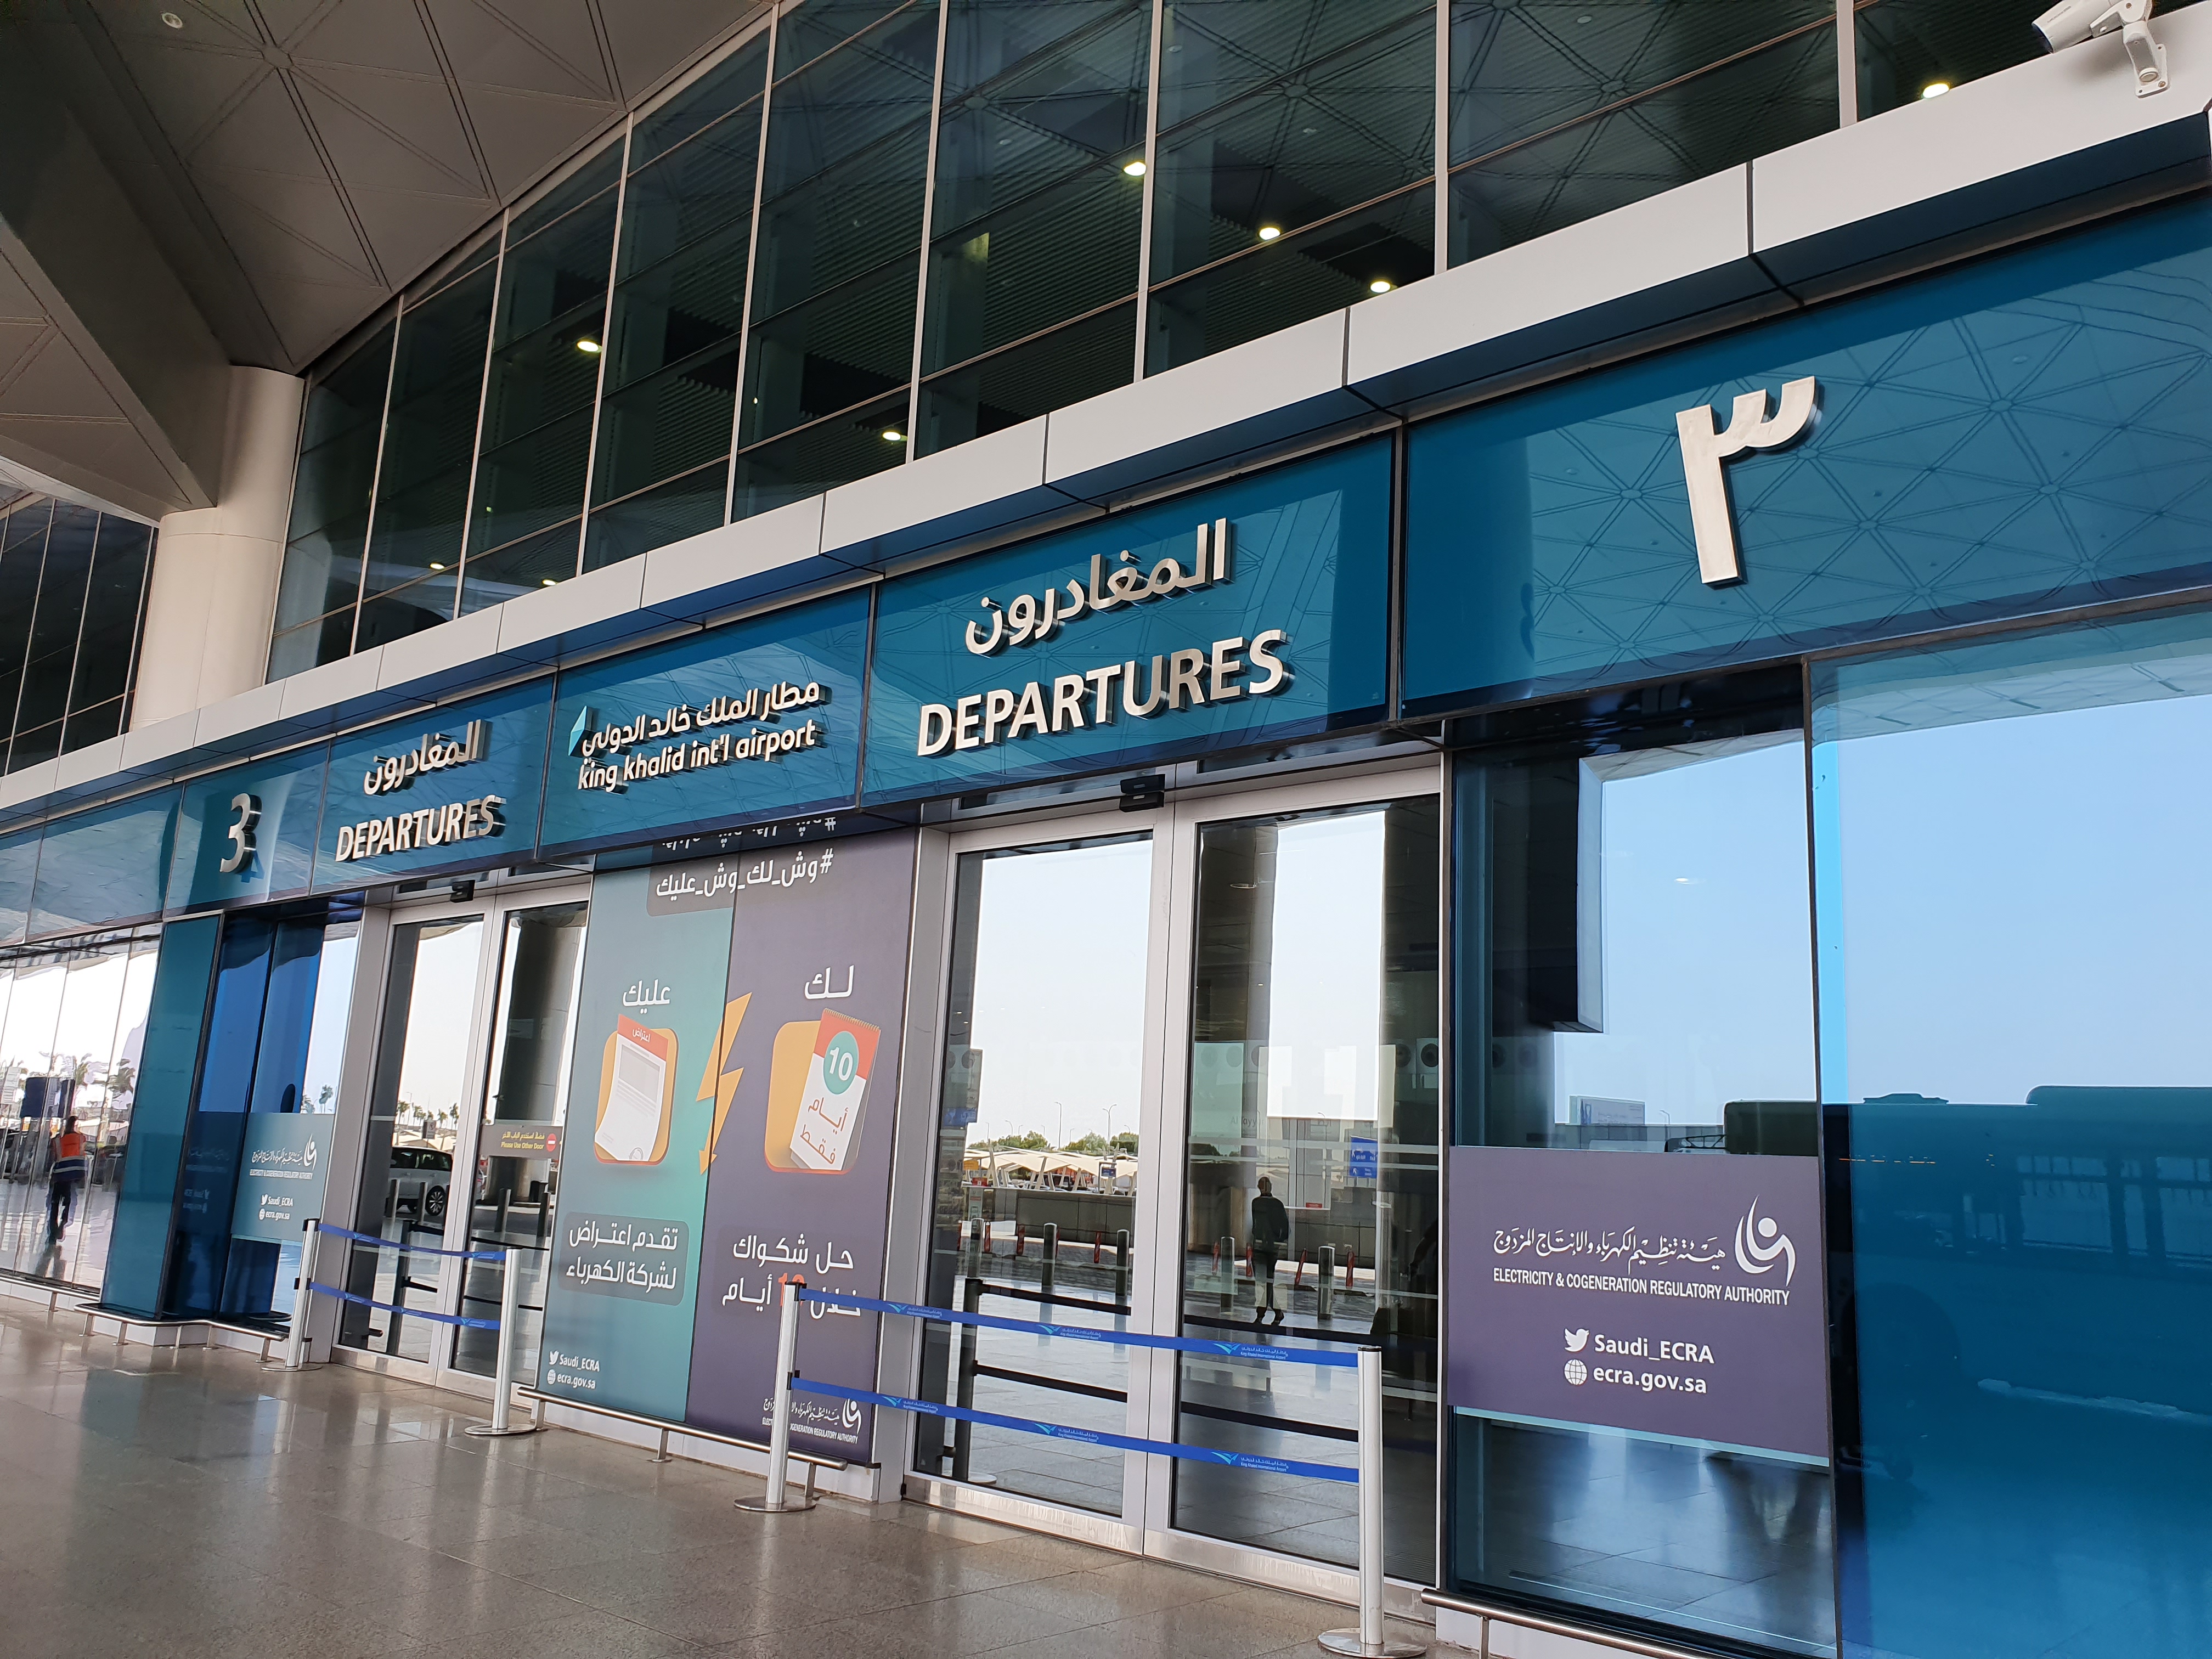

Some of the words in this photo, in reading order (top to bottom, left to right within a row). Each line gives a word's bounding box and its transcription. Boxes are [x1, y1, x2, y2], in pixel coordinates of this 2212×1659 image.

[965, 518, 1229, 656] المغادرون
[696, 688, 758, 725] الملك
[761, 681, 821, 721] مطار
[918, 629, 1286, 757] DEPARTURES
[648, 704, 691, 738] خالد
[578, 760, 618, 792] king
[624, 743, 685, 781] khalid
[736, 719, 816, 761] airport
[582, 714, 646, 765] الدولي
[363, 720, 483, 795] المغادرون
[221, 793, 255, 873] 3
[335, 795, 499, 862] DEPARTURES
[622, 979, 671, 1013] عليك
[804, 965, 854, 1000] لك
[632, 1028, 651, 1042] اعتراض
[830, 1047, 853, 1081] 10
[808, 1097, 849, 1135] أيام
[800, 1124, 836, 1164] فقط
[266, 1211, 290, 1221] ecra.gov.sa
[268, 1197, 294, 1206] Saudi_ECRA
[569, 1220, 631, 1249] اعتراض
[632, 1227, 678, 1252] تقدم
[733, 1233, 809, 1268] شكواك
[566, 1256, 625, 1285] الكهرباء
[816, 1242, 854, 1274] حل
[627, 1261, 677, 1293] لشركة
[722, 1274, 772, 1312] أيام
[1493, 1267, 1554, 1286] ELECTRICITY
[1556, 1272, 1565, 1287] &
[1566, 1273, 1647, 1294] COGENERATION
[1650, 1279, 1722, 1300] REGULATORY
[1724, 1286, 1790, 1306] AUTHORITY
[560, 1354, 600, 1372] Saudi_ECRA
[1594, 1334, 1714, 1364] Saudi_ECRA
[557, 1373, 596, 1389] ecra.gov.sa
[1593, 1367, 1707, 1393] ecra.gov.sa
[790, 1423, 813, 1435] GENERATION
[814, 1427, 837, 1440] REGULATORY
[837, 1432, 858, 1444] AUTHORITY
